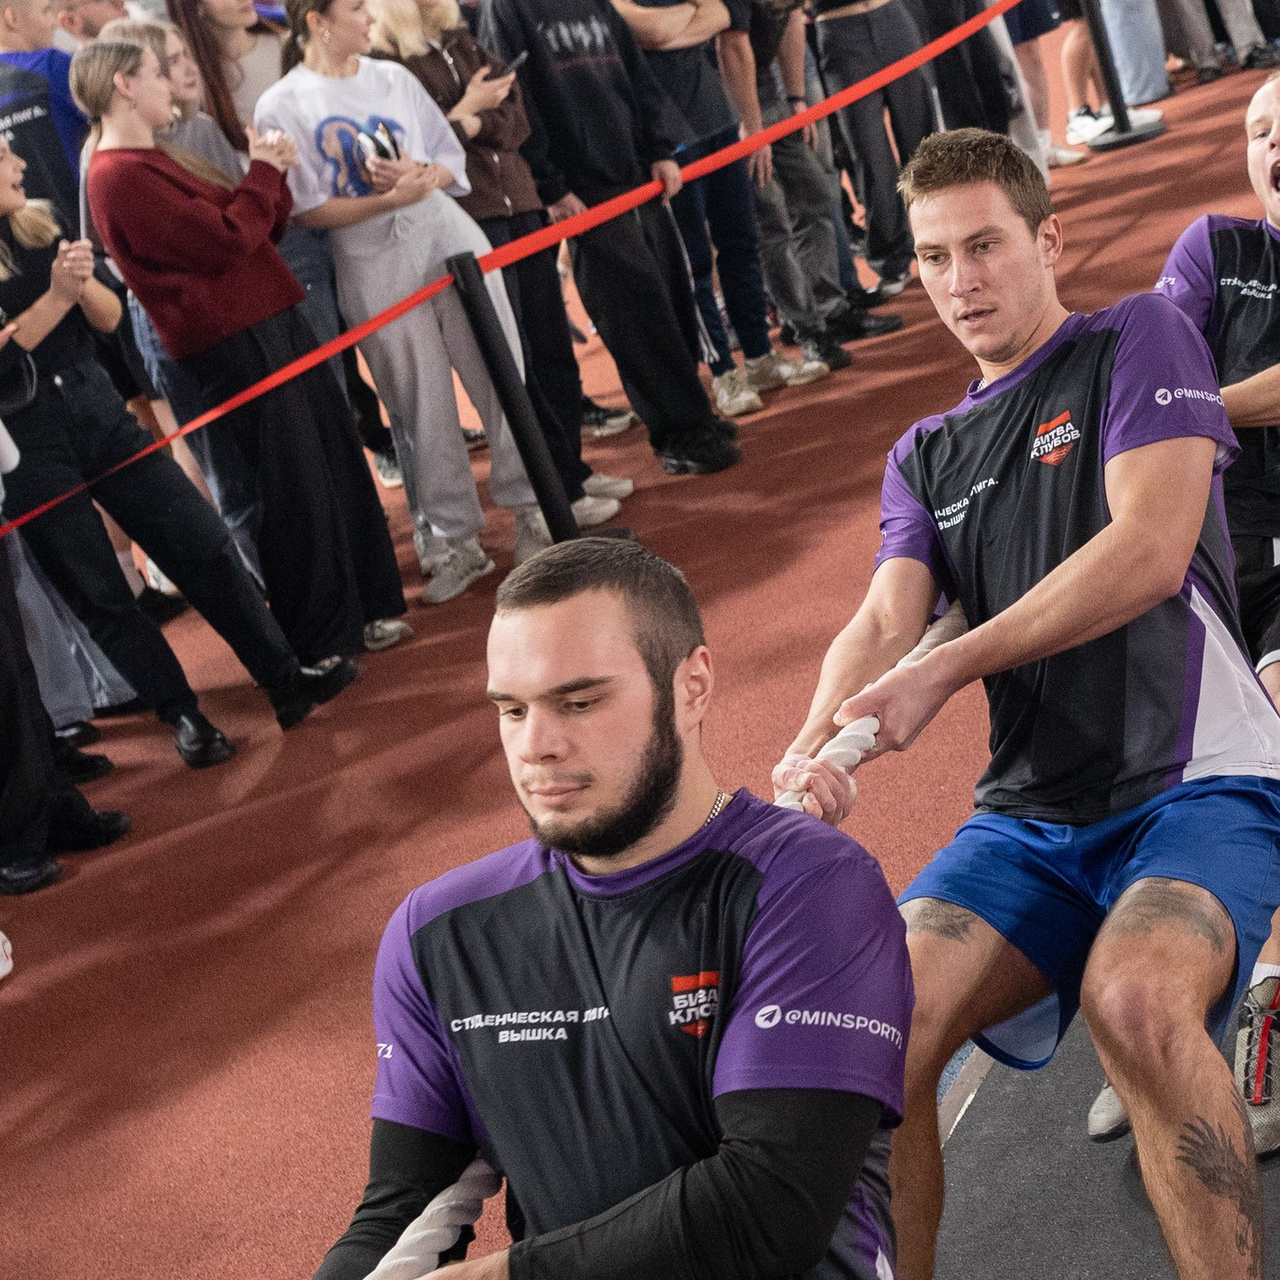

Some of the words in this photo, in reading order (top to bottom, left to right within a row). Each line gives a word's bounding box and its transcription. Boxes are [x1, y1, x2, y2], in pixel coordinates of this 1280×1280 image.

[1030, 430, 1081, 459] КЛУБОВ
[1033, 422, 1075, 449] БИТВА
[498, 1027, 568, 1043] ВЫШКА
[784, 1009, 903, 1050] @MINSPORT71
